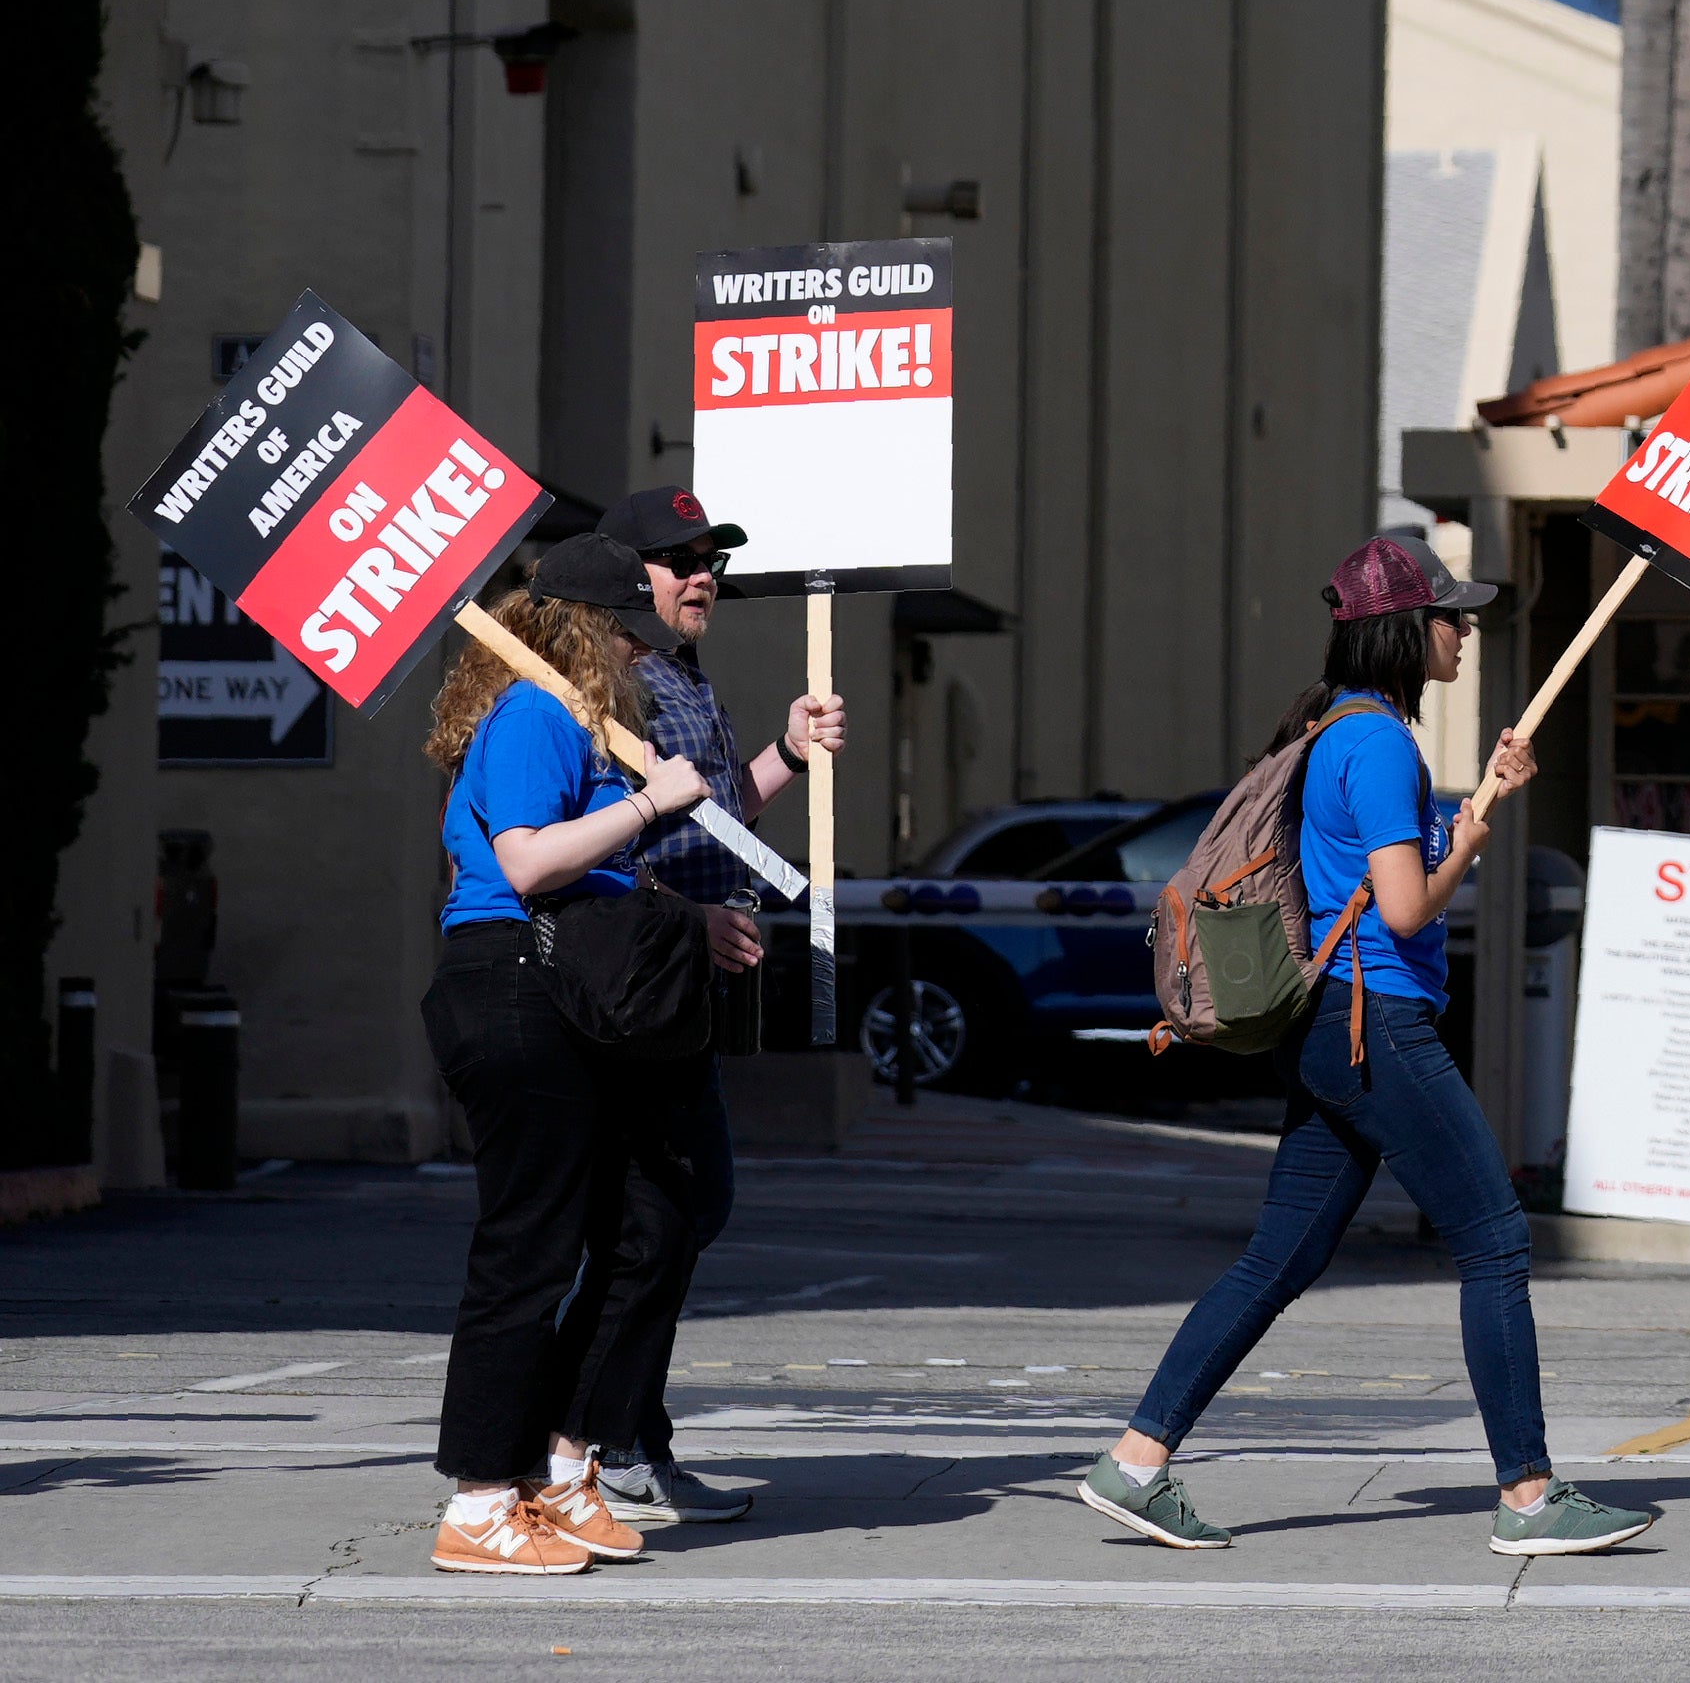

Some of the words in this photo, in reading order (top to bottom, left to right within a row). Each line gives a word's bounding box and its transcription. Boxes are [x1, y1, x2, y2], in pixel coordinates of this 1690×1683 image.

[713, 268, 842, 304] WRITERS
[848, 263, 934, 296] GUILD
[807, 305, 836, 325] ON
[711, 324, 933, 397] STRIKE!
[154, 399, 266, 524] WRITERS
[256, 321, 336, 406] GUILD
[257, 427, 290, 465] OF
[248, 410, 364, 538] AMERICA
[328, 481, 387, 542] ON
[300, 438, 506, 674] STRIKE!
[159, 676, 213, 701] ONE
[225, 677, 290, 701] WAY
